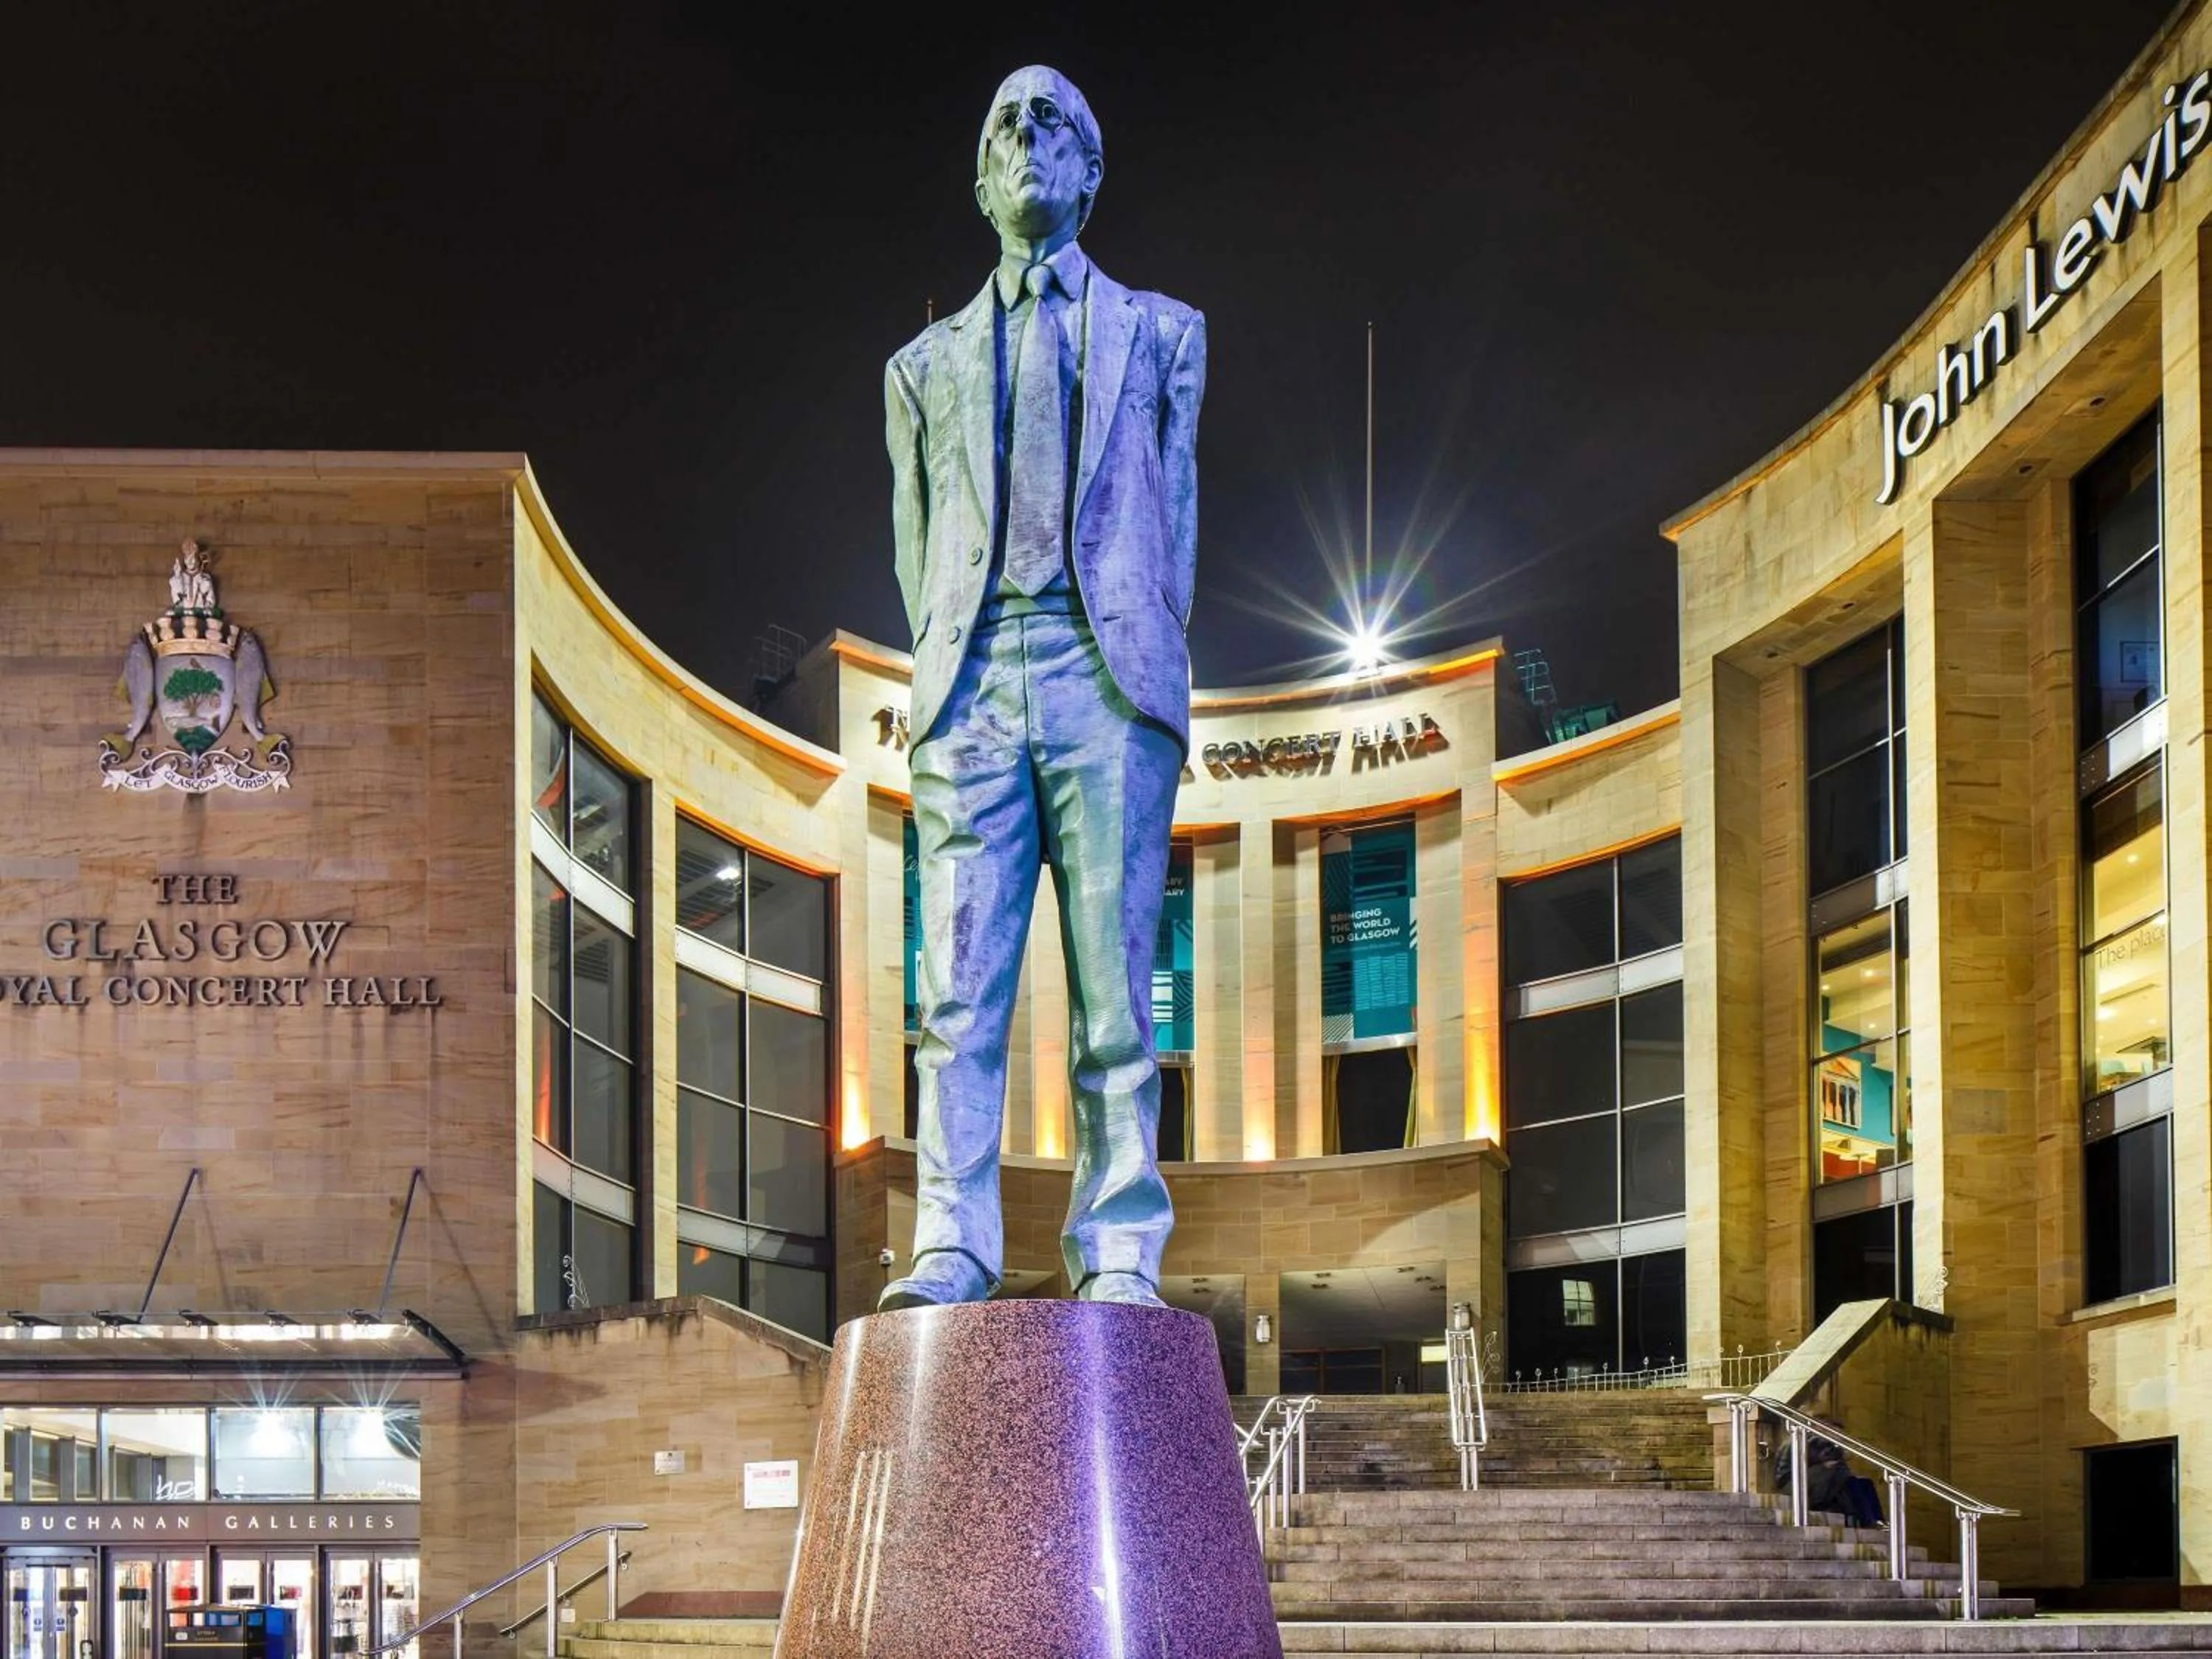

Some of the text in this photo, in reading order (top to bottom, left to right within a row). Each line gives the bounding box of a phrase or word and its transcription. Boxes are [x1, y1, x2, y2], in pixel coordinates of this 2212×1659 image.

[1876, 69, 2212, 504] John Lewis
[1202, 713, 1441, 764] CONCERT HALL
[164, 770, 219, 790] GLASGOW
[222, 765, 272, 789] FLOURISH
[153, 874, 239, 904] THE
[1330, 908, 1382, 922] BRINGING
[1331, 917, 1391, 933] THE WORLD
[43, 918, 347, 963] GLASGOW
[1331, 927, 1399, 944] TO GLASGOW
[2096, 945, 2125, 968] The
[0, 975, 442, 1006] YAL CONCERT HALL
[21, 1515, 394, 1530] BUCHANAN GALLERIES
